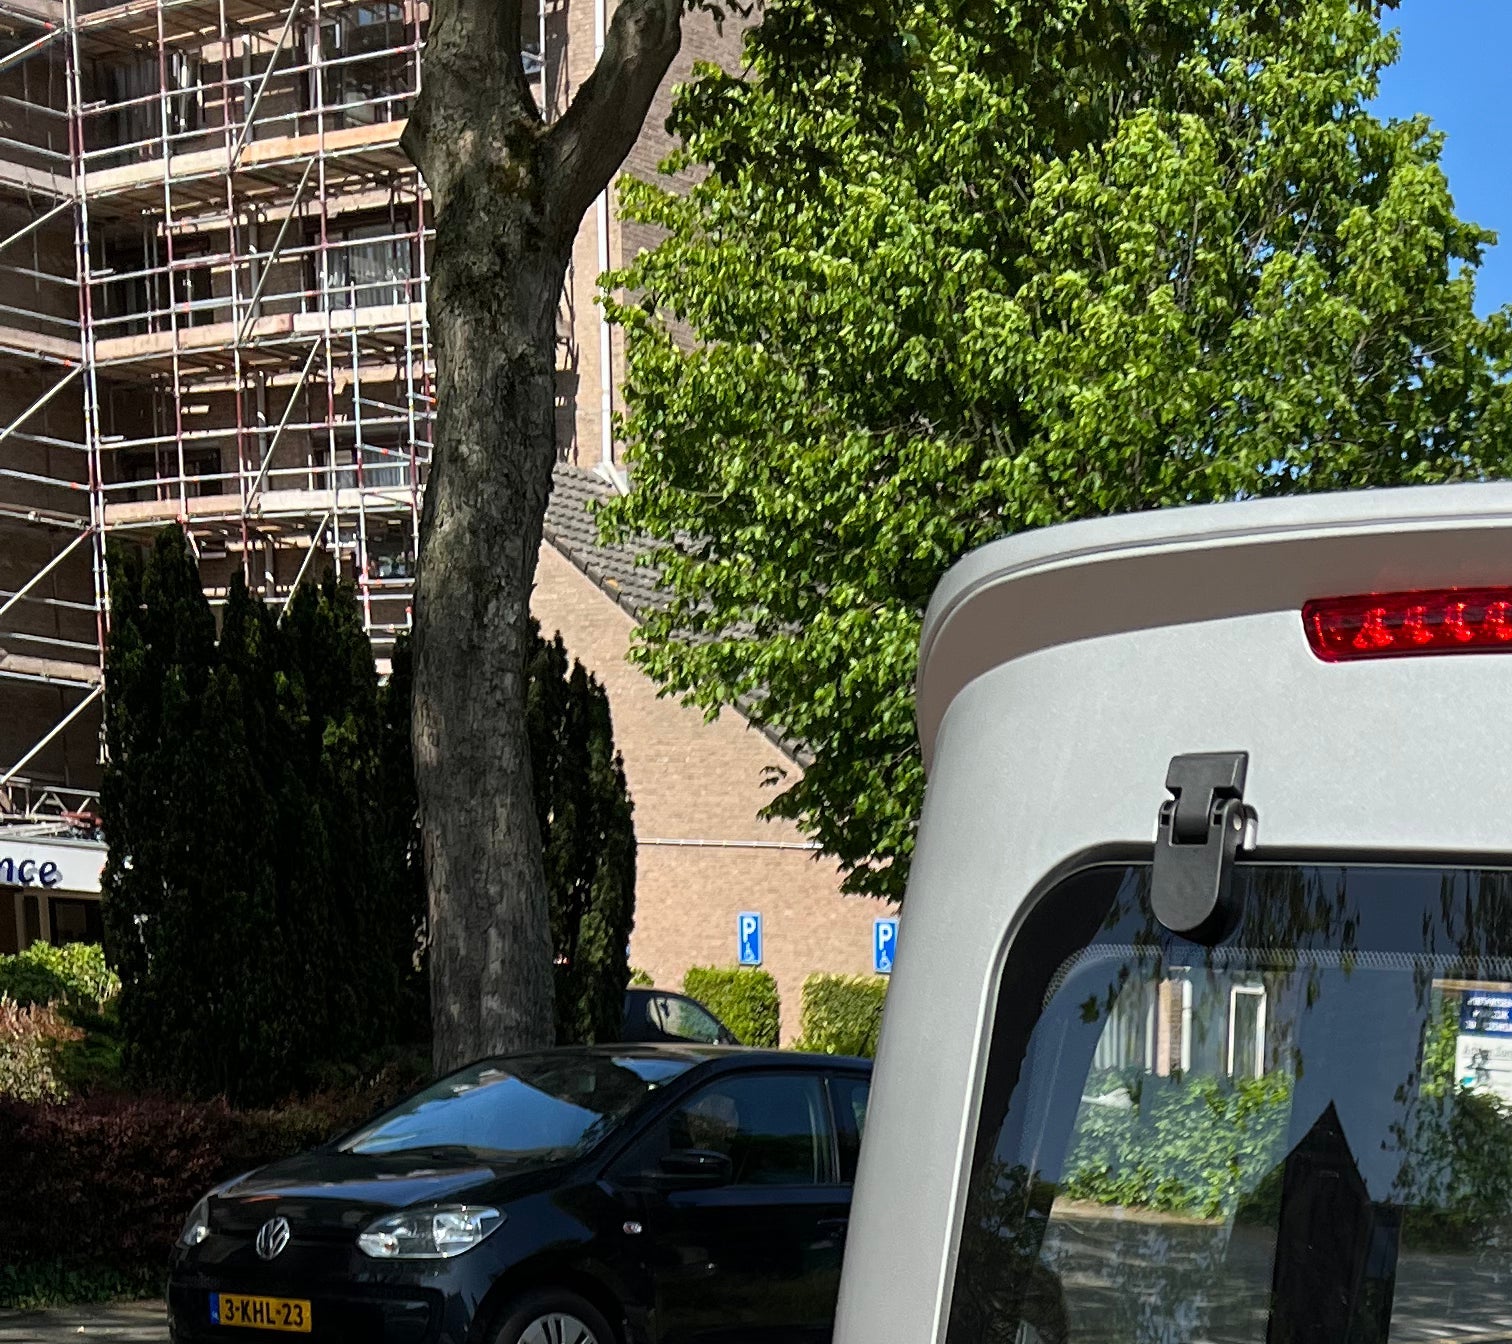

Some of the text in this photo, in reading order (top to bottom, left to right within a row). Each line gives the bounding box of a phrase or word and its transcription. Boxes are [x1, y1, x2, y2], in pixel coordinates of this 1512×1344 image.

[742, 917, 757, 944] P
[878, 923, 893, 951] P
[224, 1298, 304, 1328] 3-KHL-23
